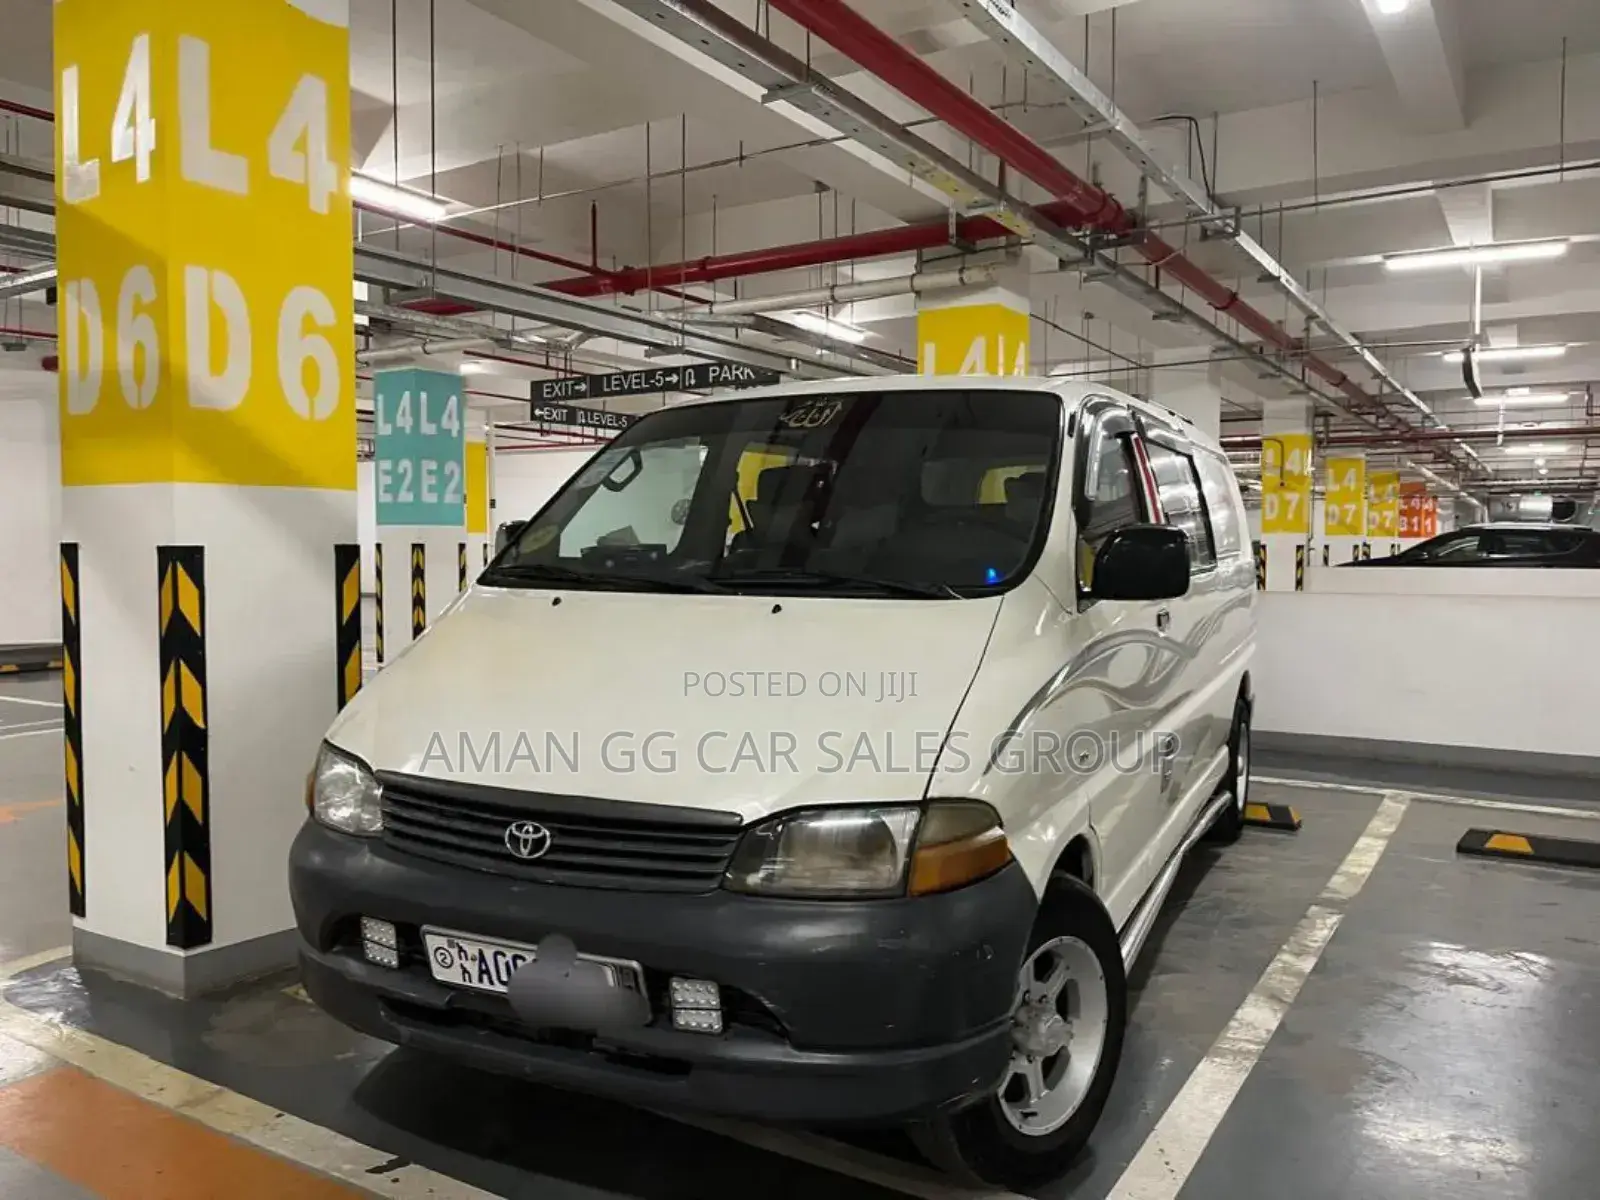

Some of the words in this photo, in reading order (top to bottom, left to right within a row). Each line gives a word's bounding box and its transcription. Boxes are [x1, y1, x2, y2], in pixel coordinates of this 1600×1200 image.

[62, 32, 155, 204] L4
[178, 34, 338, 215] L4
[65, 265, 160, 415] D6
[184, 264, 340, 421] D6
[543, 381, 575, 398] EXIT
[604, 371, 664, 392] LEVEL-5
[377, 390, 413, 435] L4
[420, 391, 460, 437] L4
[543, 407, 568, 421] EXIT
[588, 412, 628, 428] LEVEL-5
[378, 459, 414, 503] E2
[421, 459, 461, 504] E2
[1328, 467, 1357, 492] L4
[1265, 492, 1300, 520] D7
[1327, 503, 1357, 525] D7
